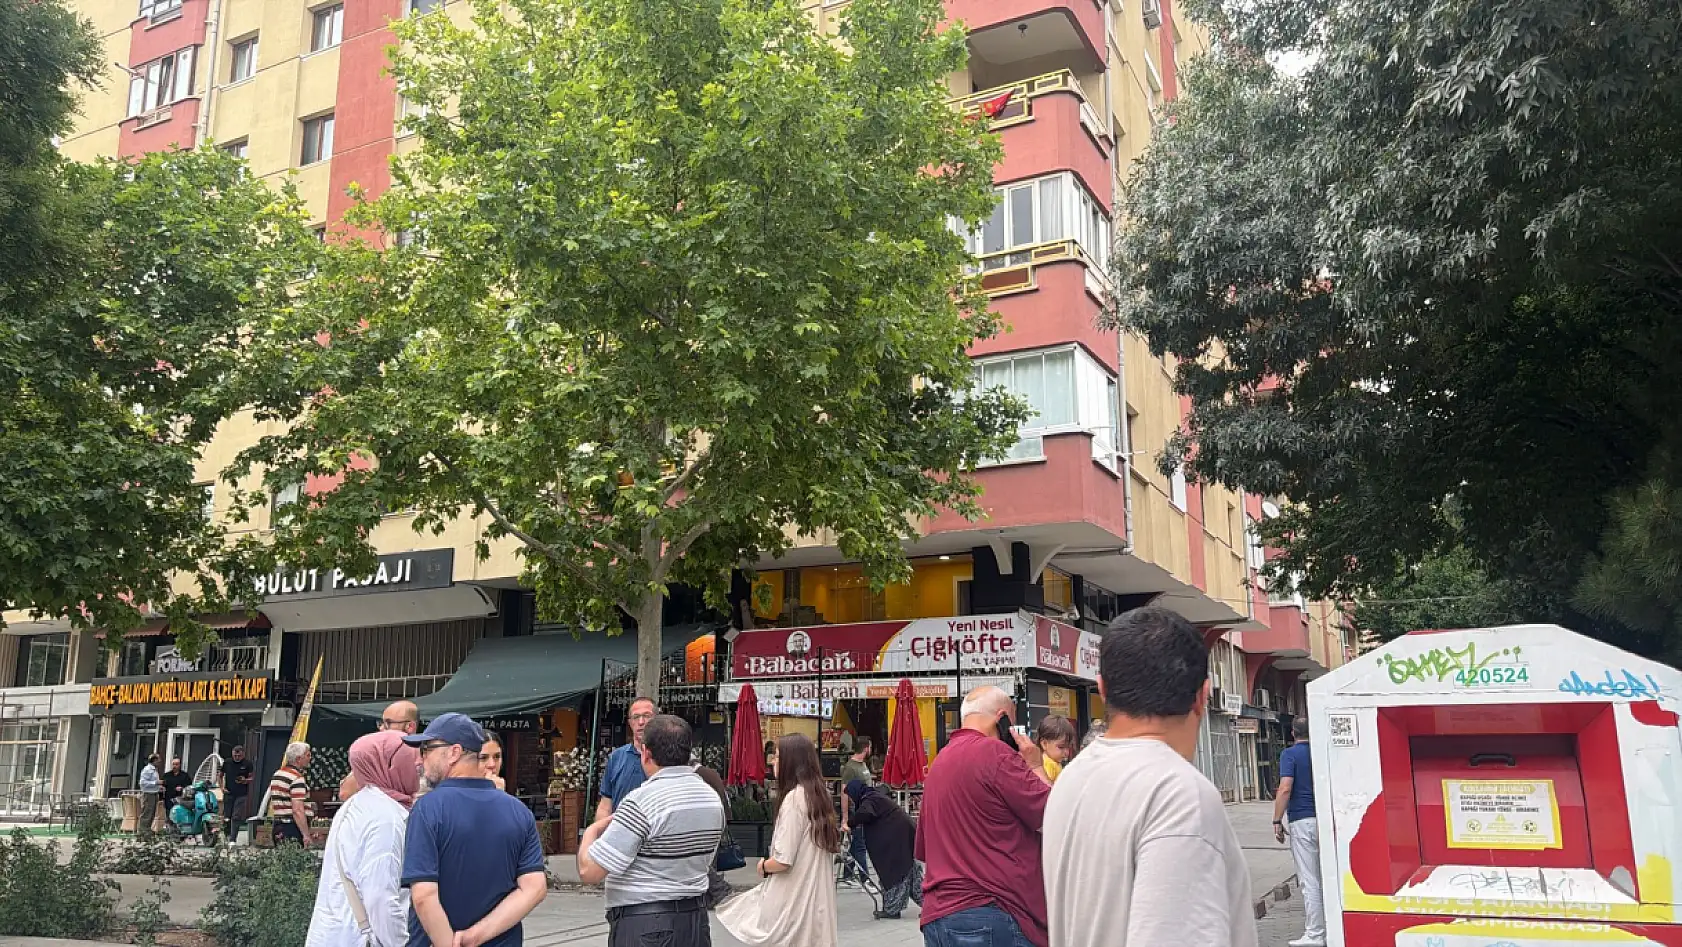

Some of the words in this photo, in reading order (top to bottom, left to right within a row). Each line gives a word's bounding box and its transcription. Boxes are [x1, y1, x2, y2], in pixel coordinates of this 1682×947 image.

[255, 568, 318, 595] BULUT
[947, 619, 976, 633] Yeni
[980, 617, 1014, 631] Nesil
[910, 633, 1013, 662] Çiğköfte
[749, 653, 851, 675] Babacan
[1455, 667, 1529, 684] 420524
[151, 676, 208, 703] MOBİLYALARI
[208, 680, 216, 701] &
[217, 673, 242, 706] ÇELİK
[244, 677, 267, 699] KAPI
[791, 682, 859, 699] Babacan
[500, 720, 530, 729] PASTA
